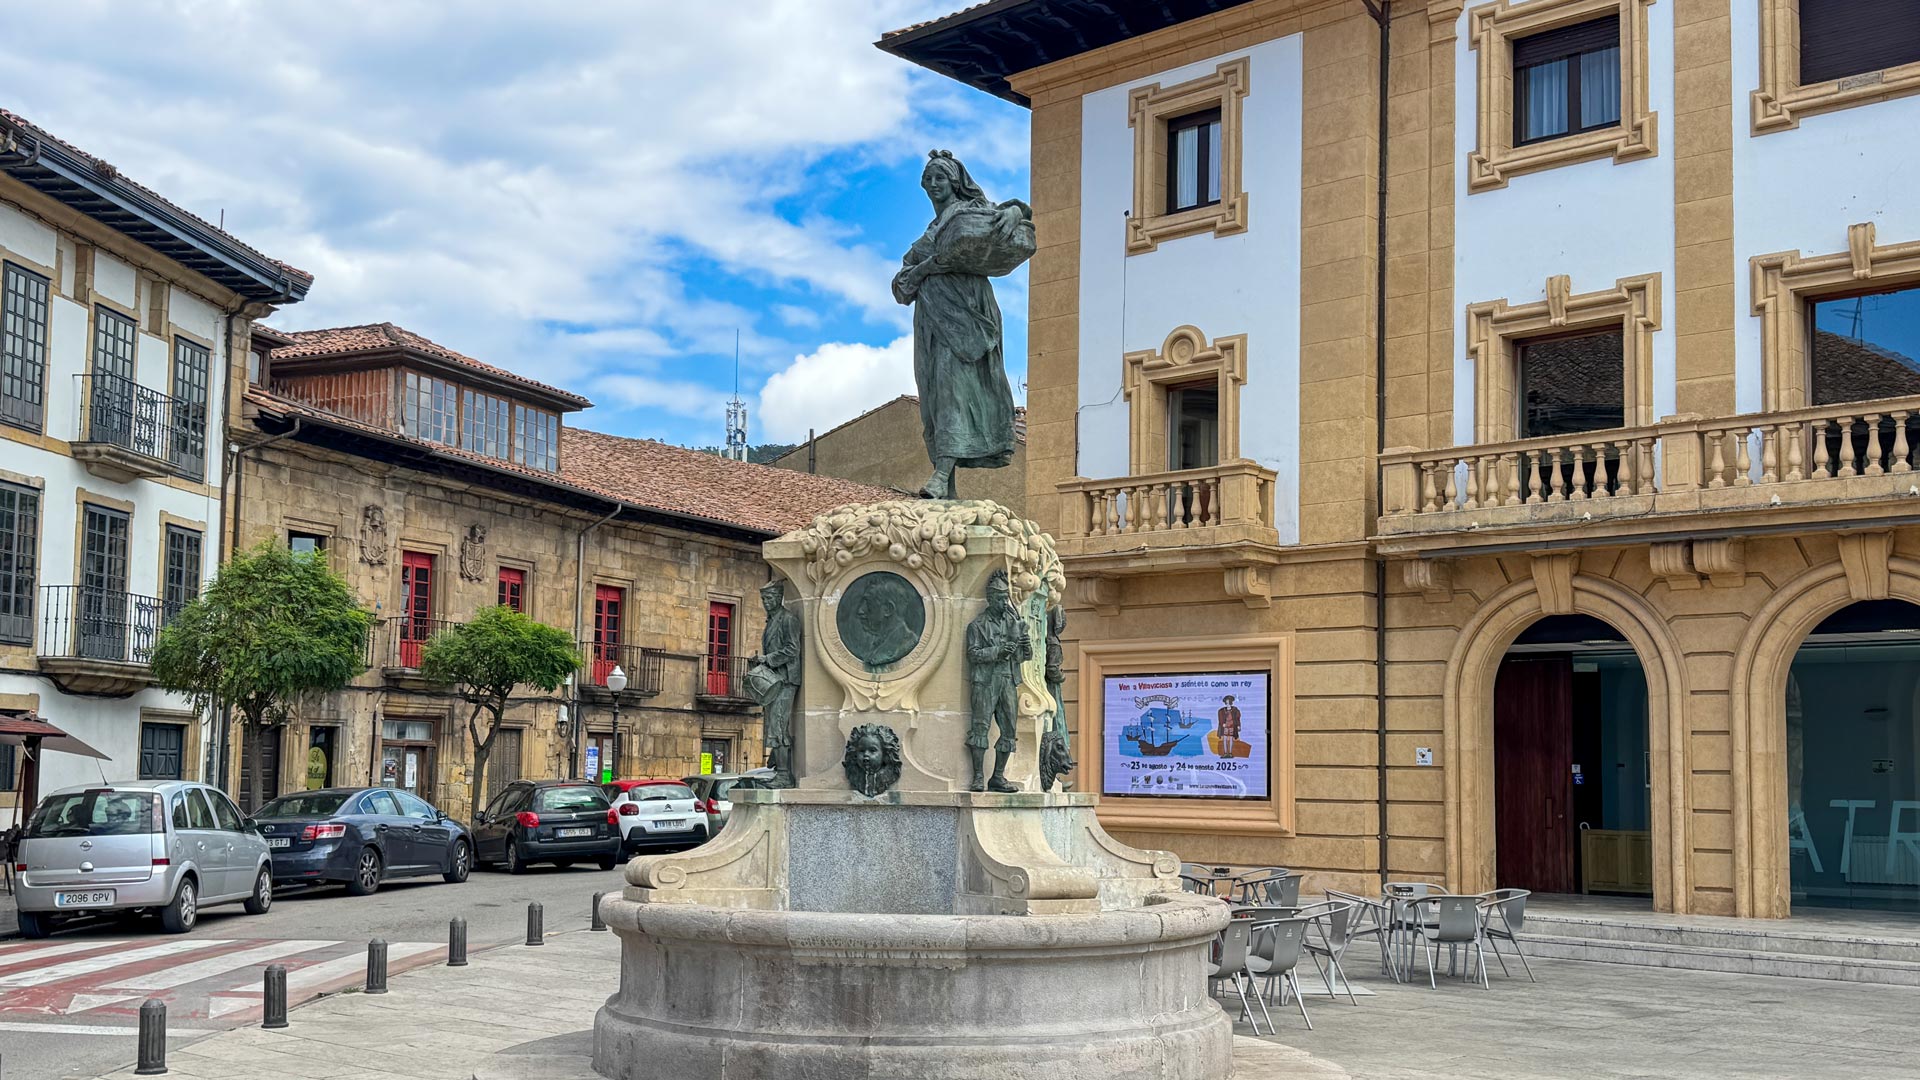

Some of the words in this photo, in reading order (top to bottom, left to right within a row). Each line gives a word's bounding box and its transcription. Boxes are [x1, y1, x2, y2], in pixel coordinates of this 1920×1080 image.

[1119, 683, 1130, 691] Ven
[1138, 682, 1172, 690] Villaviciosa
[1130, 761, 1140, 770] 23
[1170, 764, 1175, 773] y
[1176, 762, 1187, 771] 24
[1216, 761, 1238, 771] 2025
[66, 893, 89, 903] 2096
[92, 893, 110, 902] GPV
